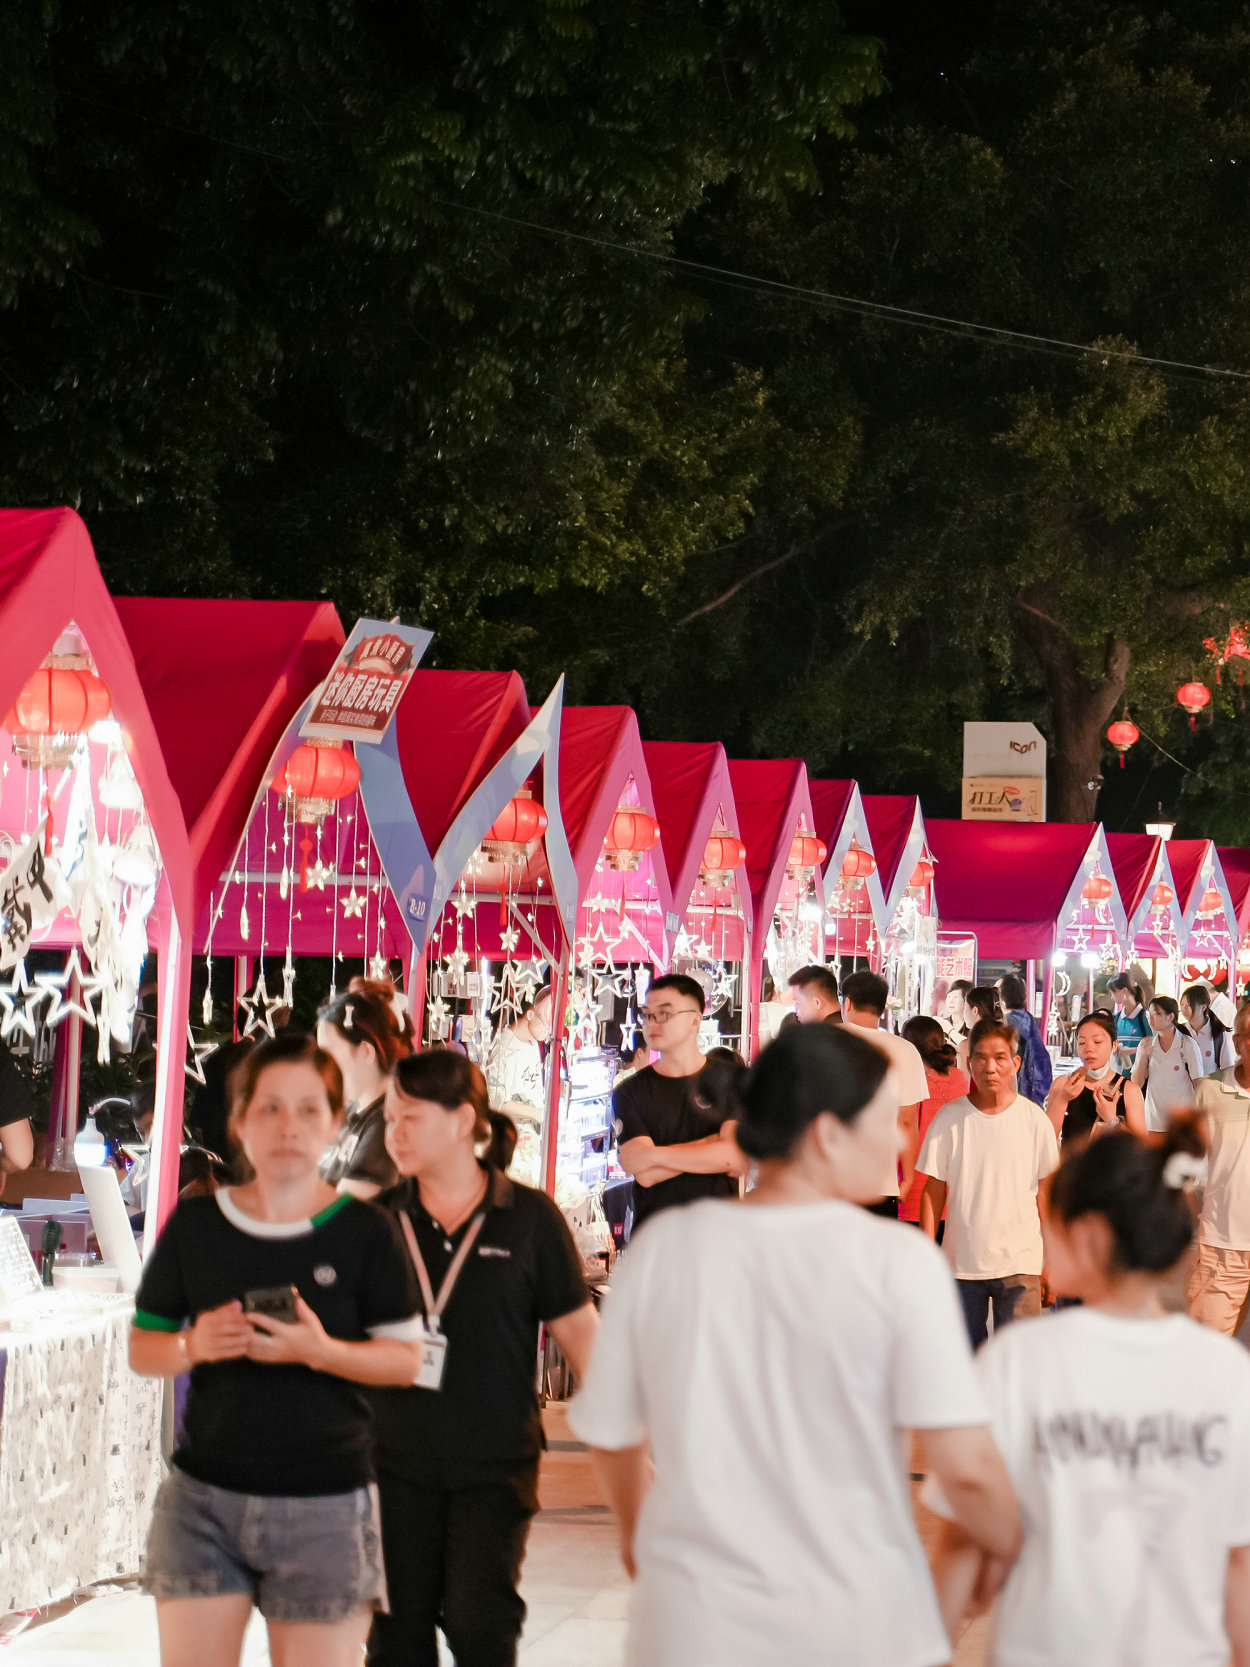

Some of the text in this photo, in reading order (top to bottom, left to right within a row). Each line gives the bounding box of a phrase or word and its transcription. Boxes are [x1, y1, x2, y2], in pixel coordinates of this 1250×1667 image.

[320, 671, 403, 714] 迷你厨房玩具
[969, 791, 1012, 807] 打工人
[409, 898, 426, 917] B-10
[937, 956, 973, 977] 能艺术照
